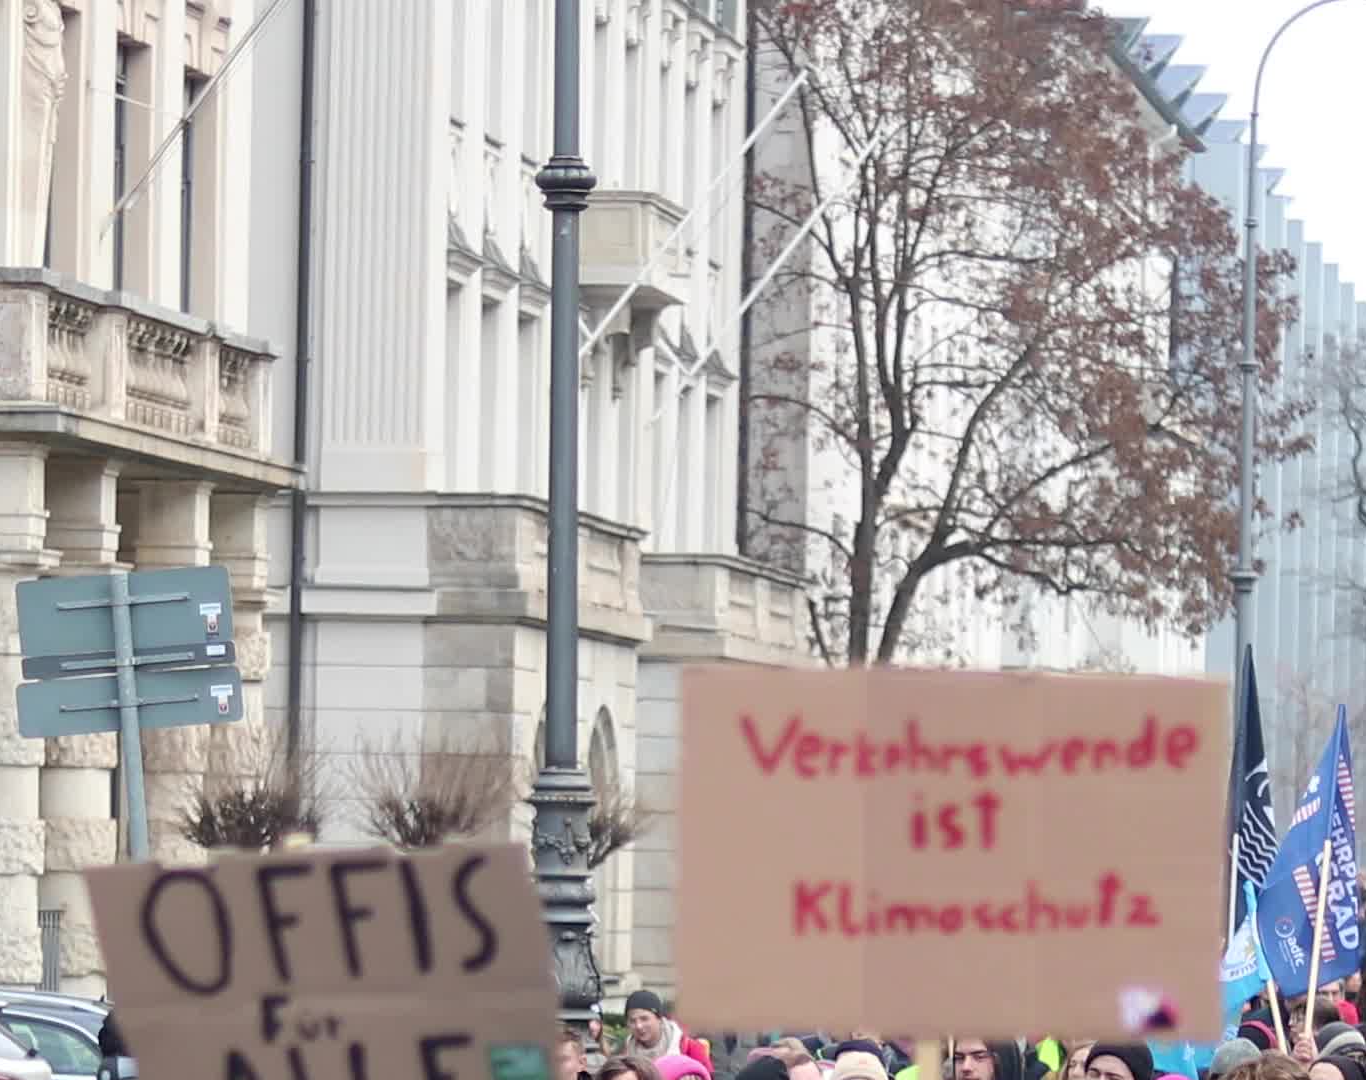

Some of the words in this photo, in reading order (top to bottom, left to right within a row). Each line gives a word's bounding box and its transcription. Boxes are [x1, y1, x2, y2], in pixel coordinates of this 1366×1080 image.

[739, 713, 1201, 779] Verkehrswende
[907, 792, 1002, 851] ist
[140, 853, 501, 996] OFFIS
